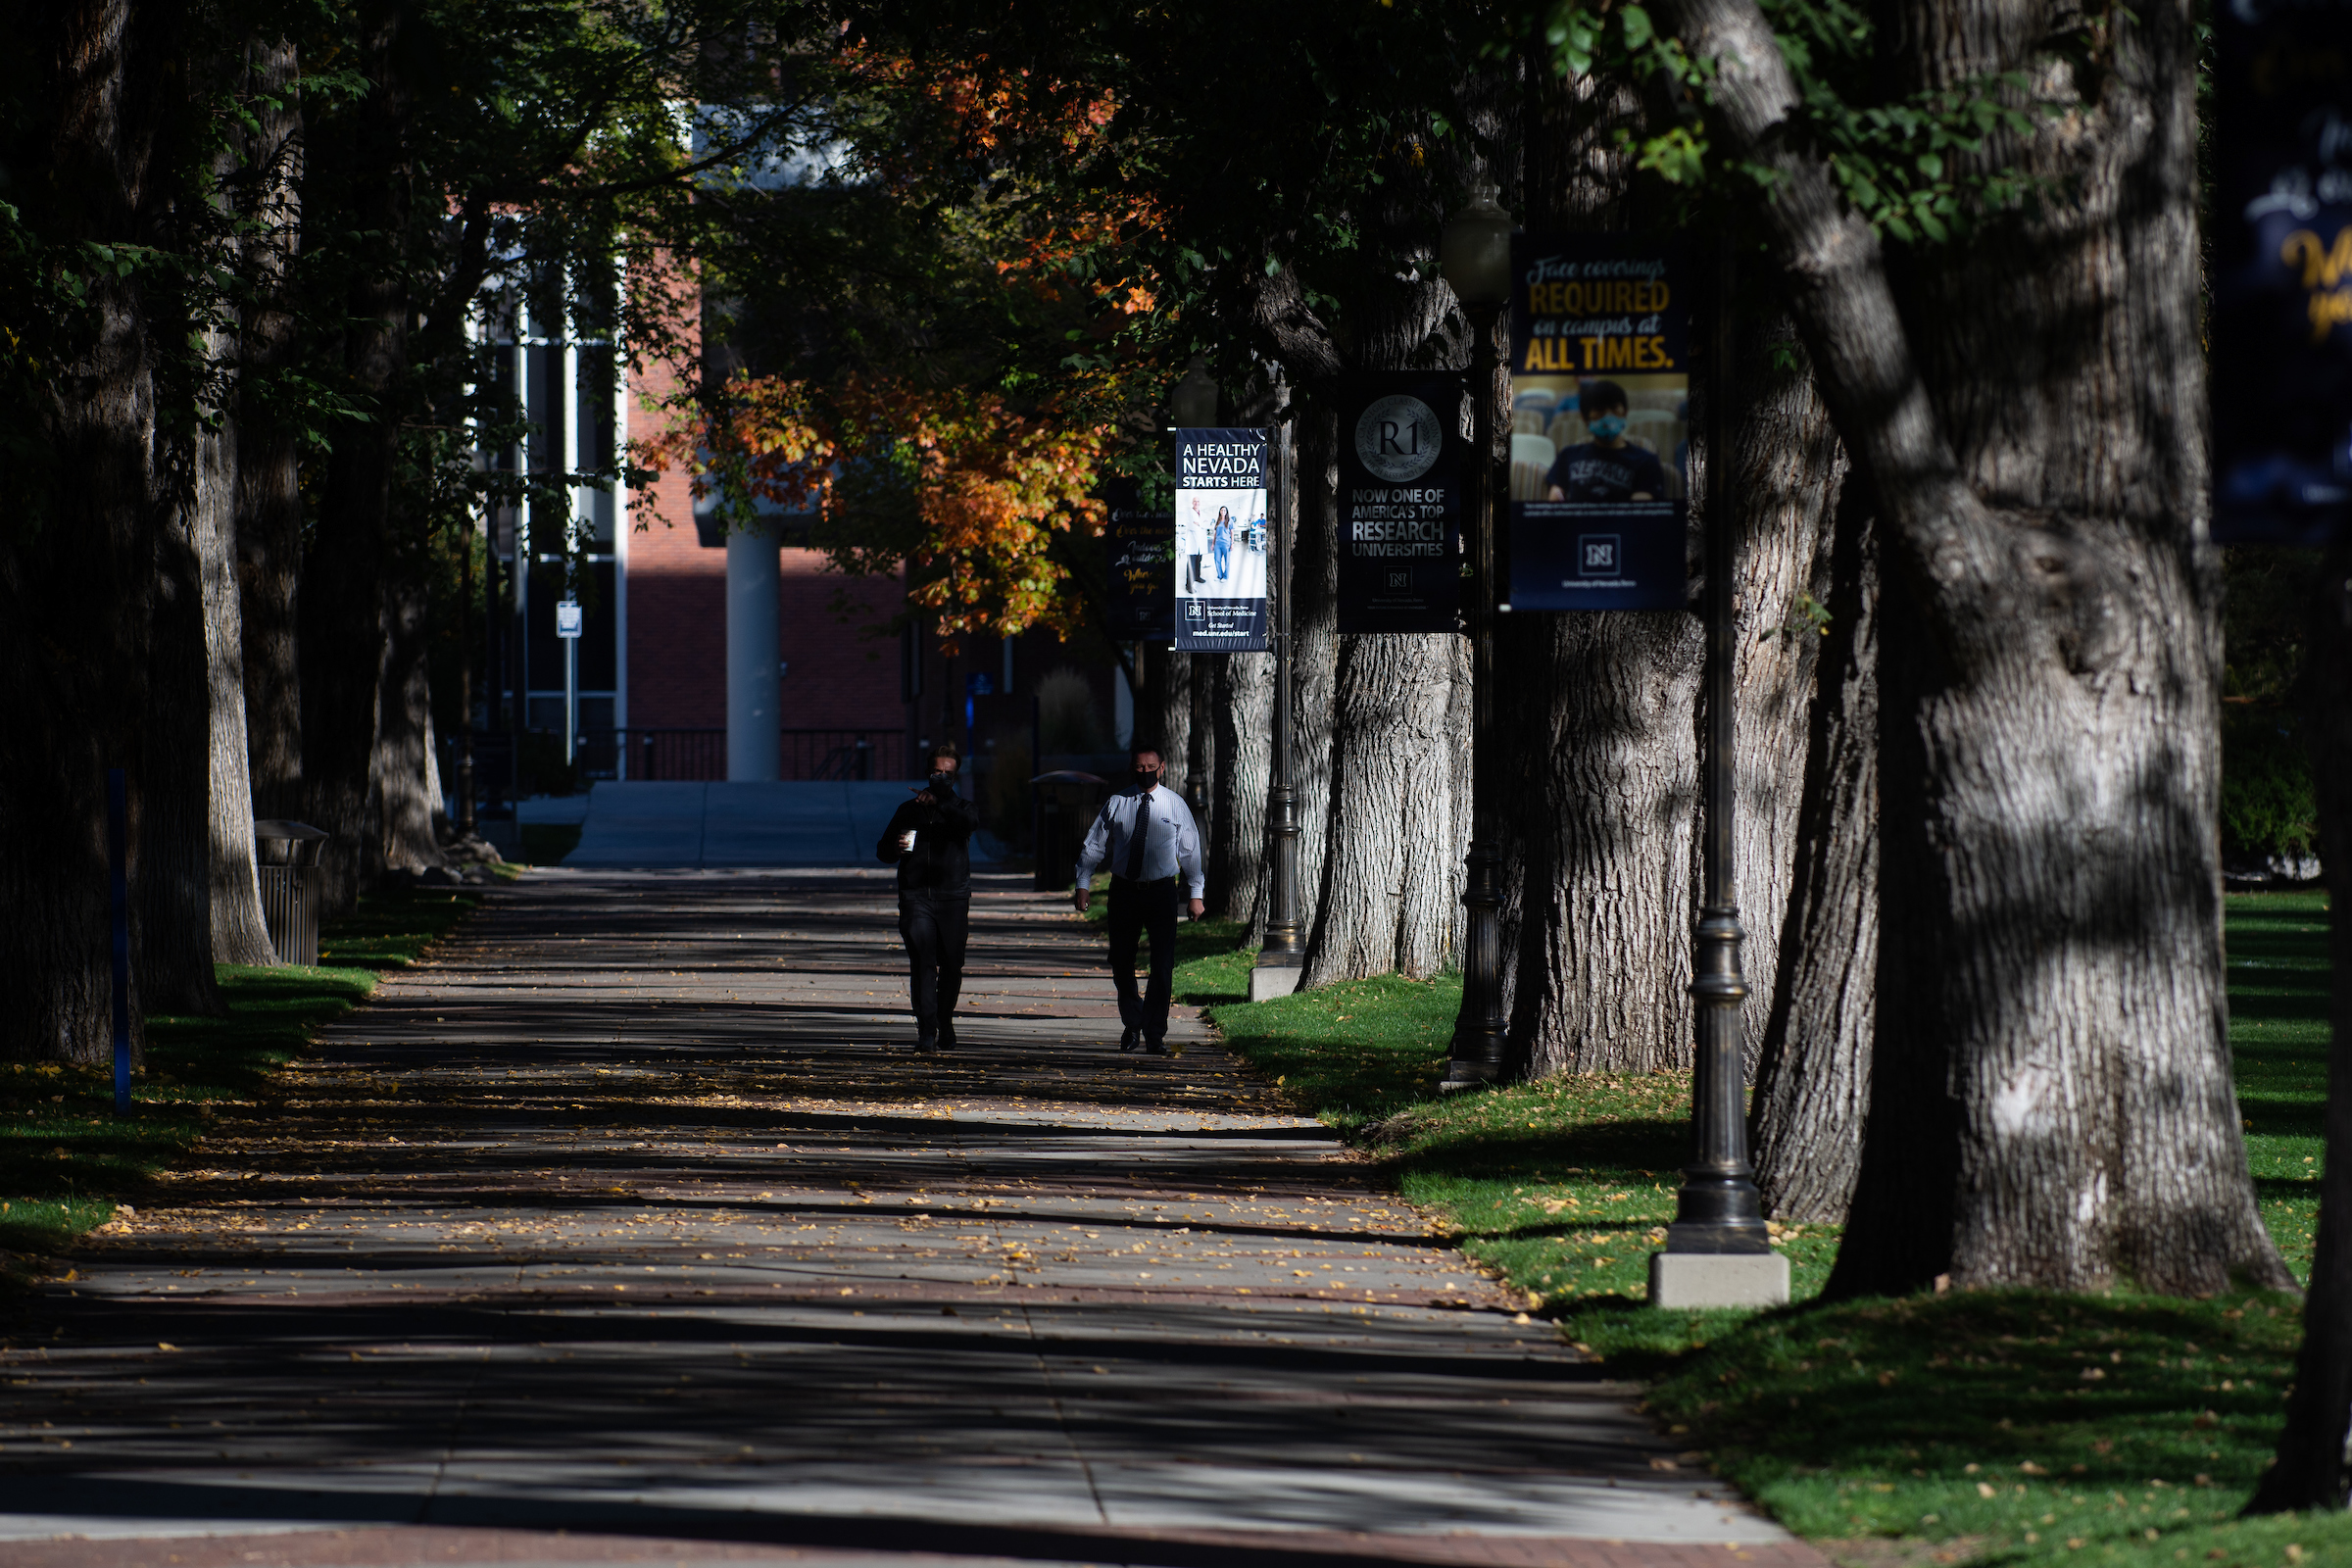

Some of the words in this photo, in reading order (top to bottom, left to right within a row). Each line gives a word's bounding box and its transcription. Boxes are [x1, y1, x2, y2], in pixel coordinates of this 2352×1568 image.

[1526, 254, 1580, 287] Face
[1583, 258, 1668, 288] coverings
[1529, 279, 1671, 318] REQUIRED
[1532, 319, 1558, 337] on
[1561, 316, 1634, 345] campus
[1637, 313, 1662, 335] at
[1524, 338, 1575, 371] ALL
[1579, 335, 1675, 370] TIMES.
[1376, 420, 1421, 456] R1
[1183, 444, 1194, 457] A
[1198, 443, 1260, 457] HEALTHY
[1183, 458, 1260, 474] NEVADA
[1383, 467, 1418, 480] RESEARCH
[1182, 476, 1229, 487] STARTS
[1231, 476, 1260, 487] HERE
[1352, 488, 1389, 503] NOW
[1392, 488, 1422, 503] ONE
[1424, 488, 1445, 503] OF
[1351, 505, 1416, 519] AMERICA'S
[1419, 505, 1445, 519] TOP
[1352, 520, 1445, 541] RESEARCH
[1352, 543, 1445, 557] UNIVERSITIES
